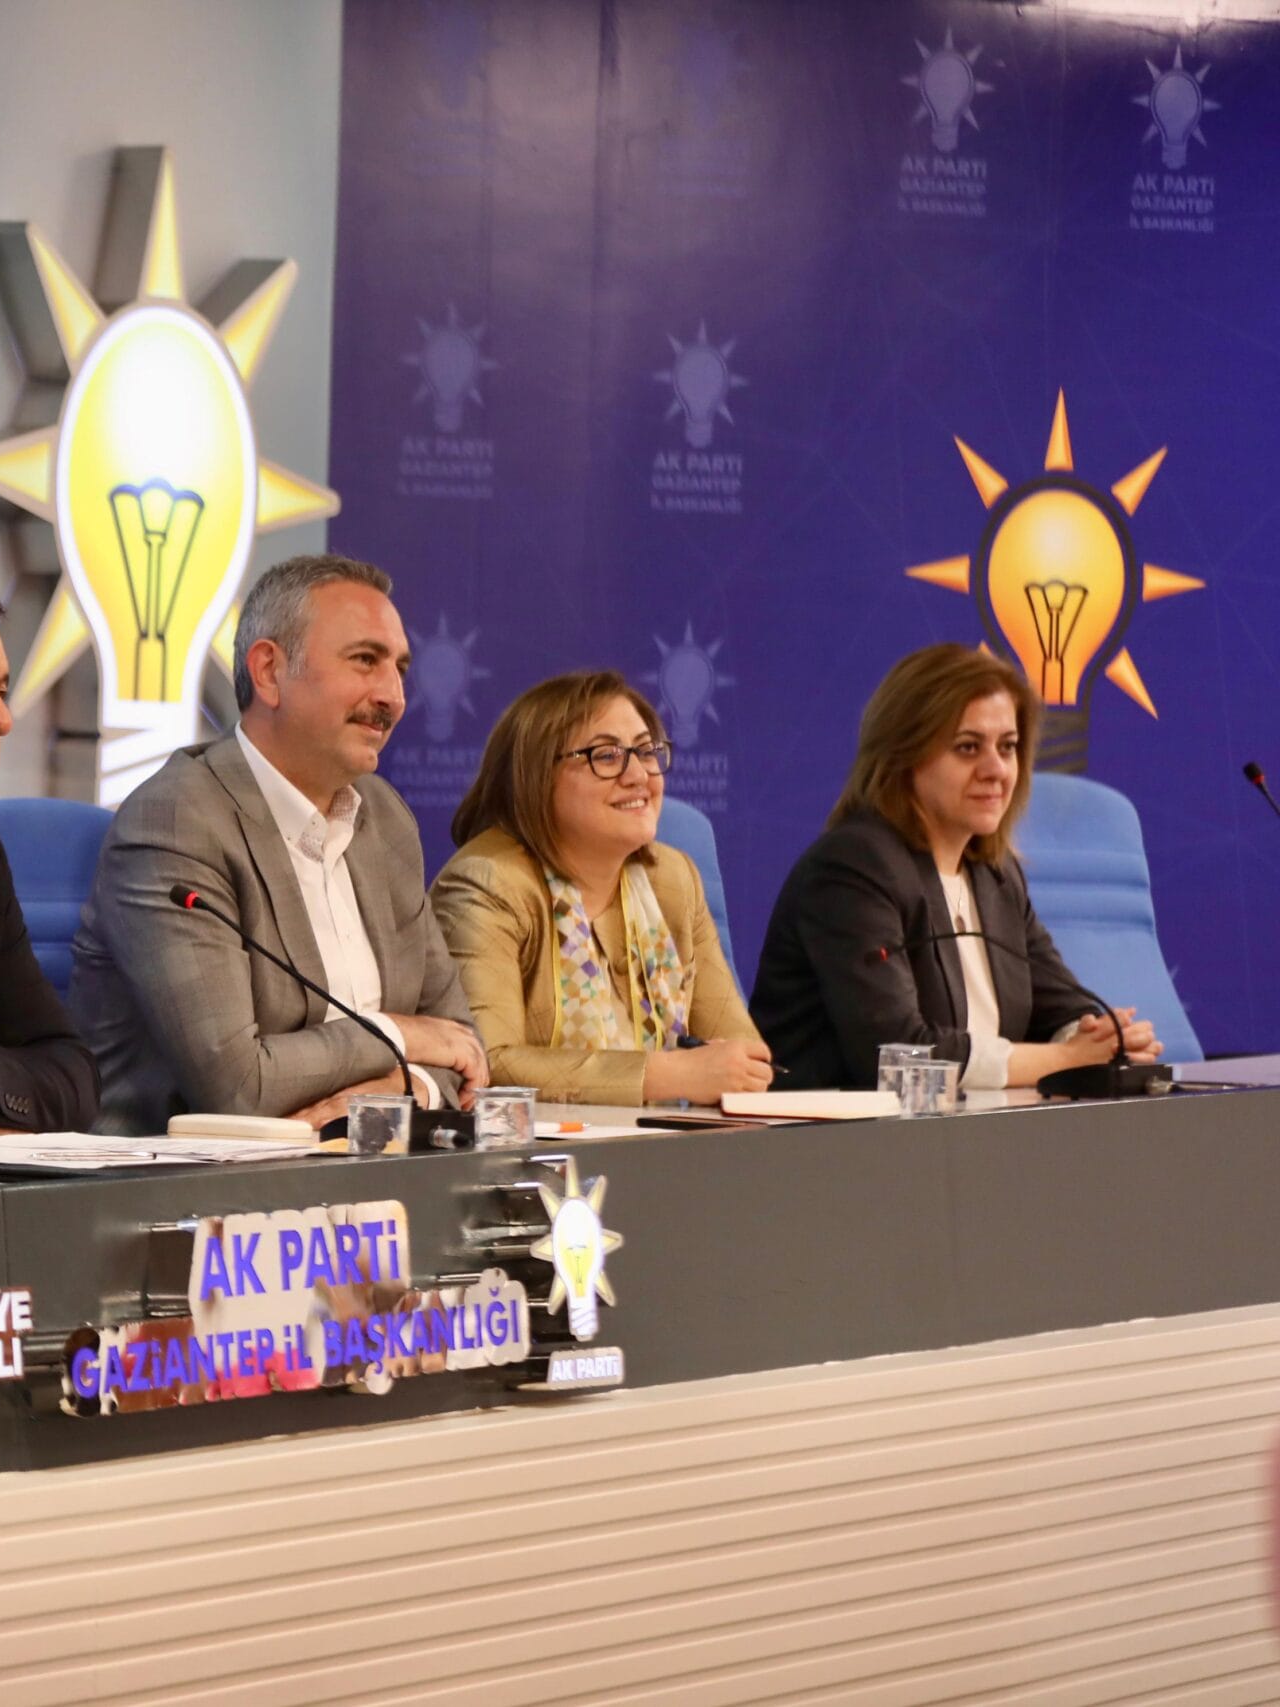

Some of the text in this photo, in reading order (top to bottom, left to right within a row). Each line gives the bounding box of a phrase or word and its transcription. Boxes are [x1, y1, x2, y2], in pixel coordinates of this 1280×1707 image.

[901, 154, 927, 175] AK
[1132, 173, 1157, 192] AK
[653, 450, 681, 471] AK
[200, 1232, 266, 1301] AK
[323, 1286, 520, 1375] BAŞKANLIĞI
[552, 1359, 576, 1382] AK
